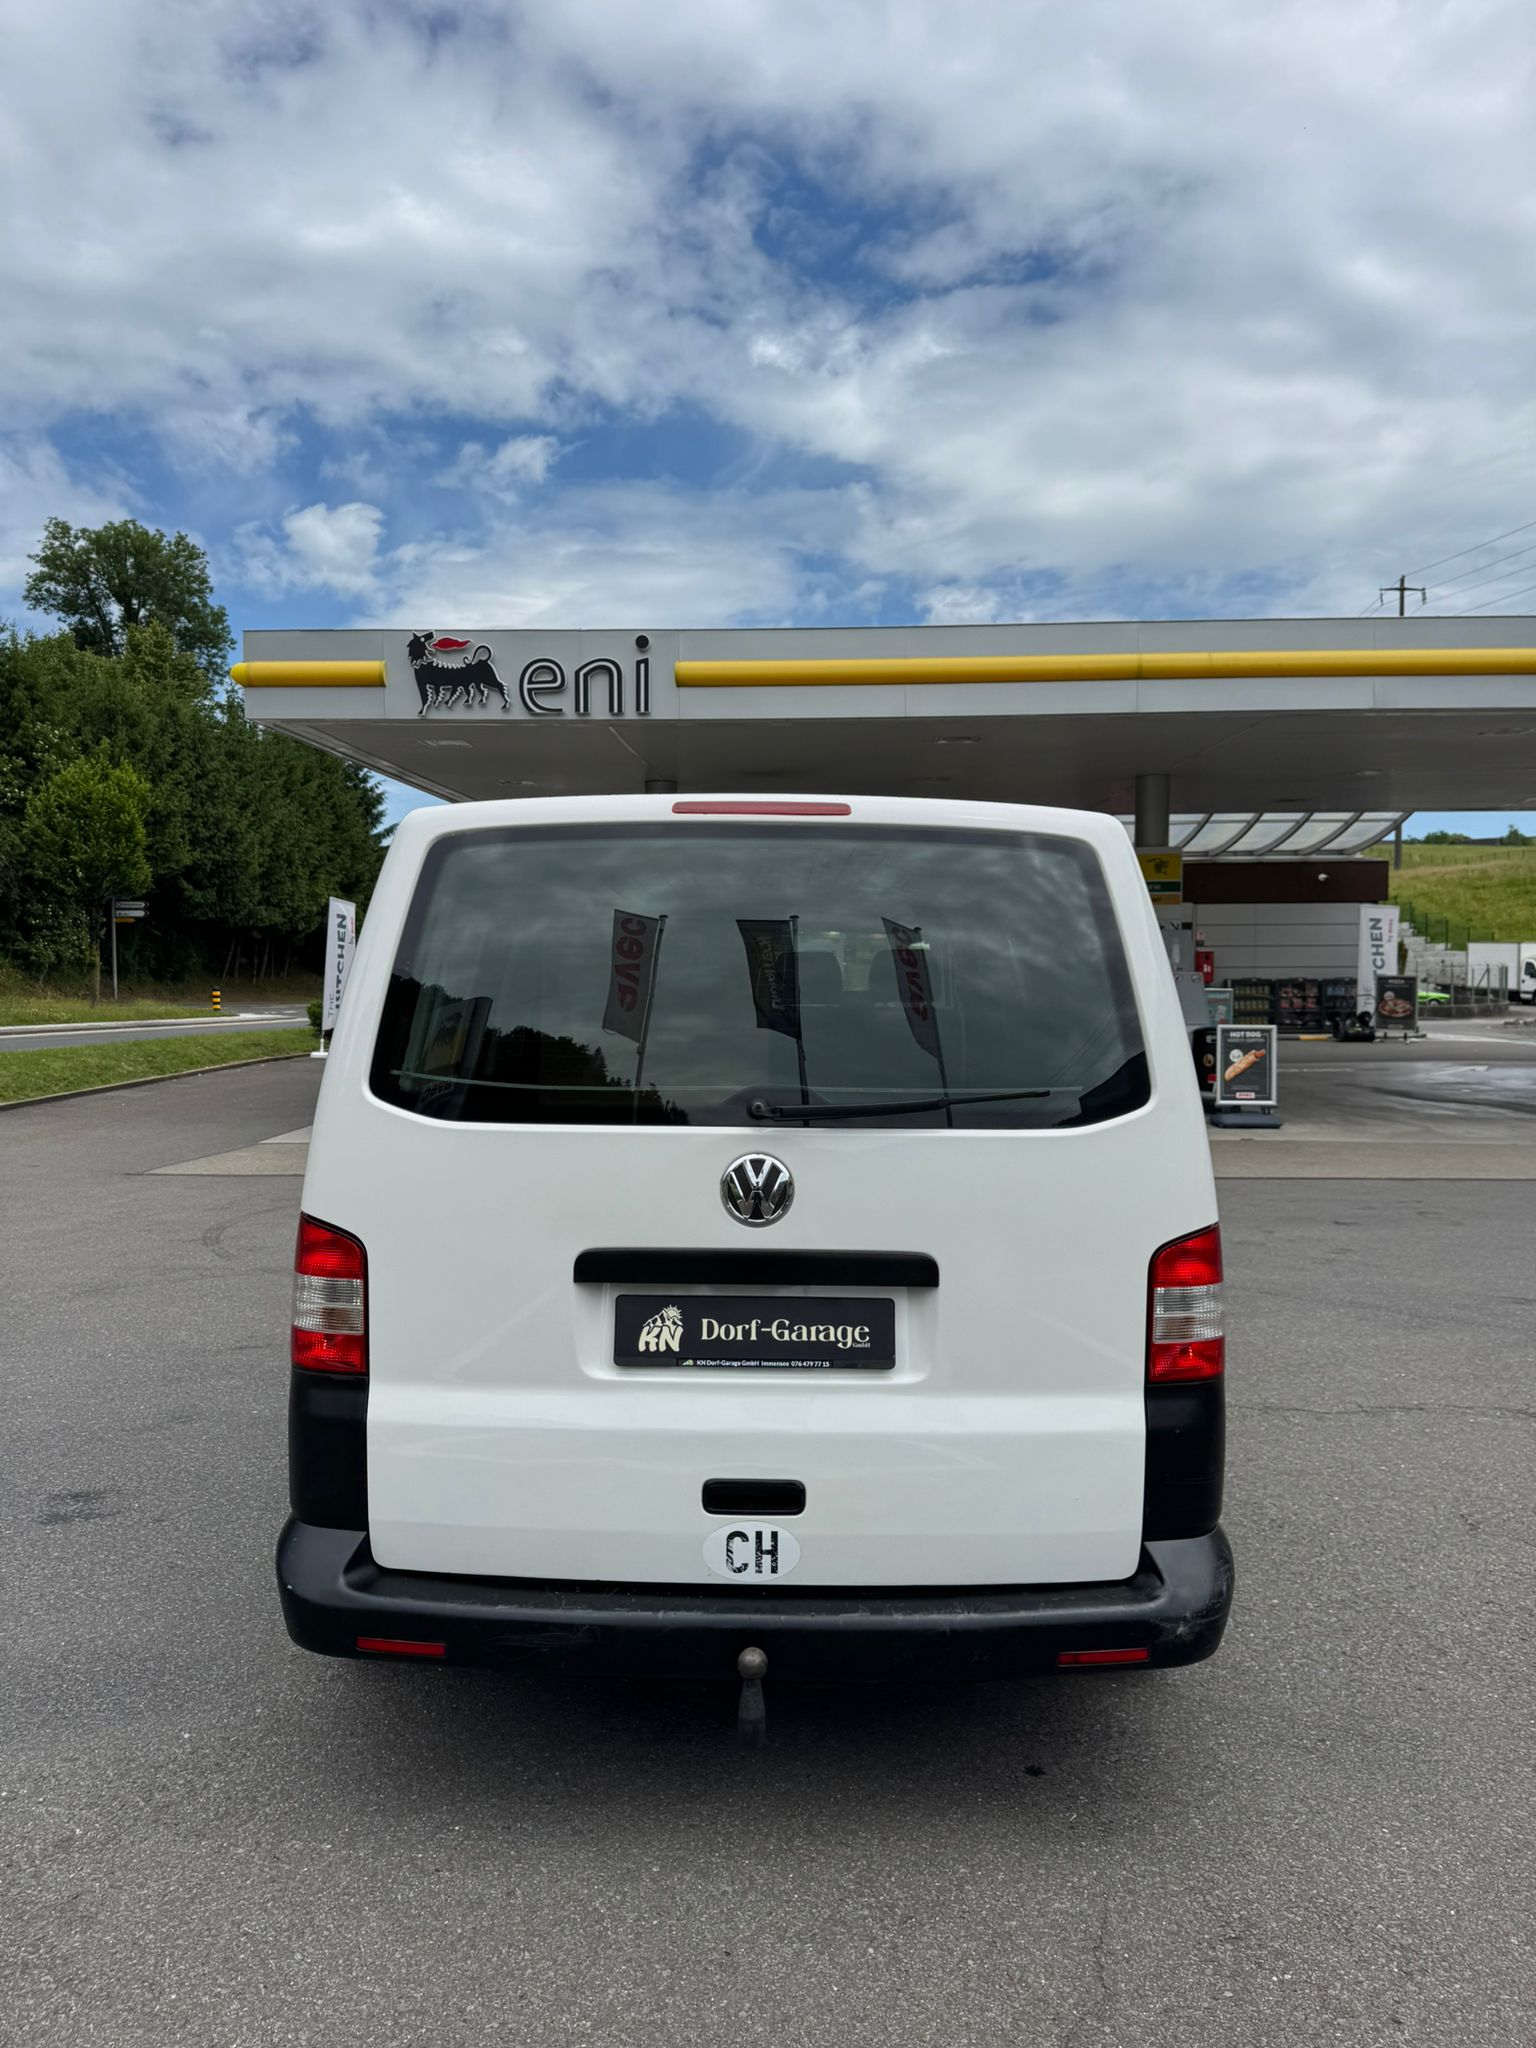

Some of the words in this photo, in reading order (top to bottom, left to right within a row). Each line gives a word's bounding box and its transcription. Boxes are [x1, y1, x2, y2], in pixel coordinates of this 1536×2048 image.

[518, 634, 651, 714] eni
[637, 1325, 685, 1352] KN
[701, 1318, 870, 1349] Dorf-Garage
[725, 1530, 779, 1574] CH
